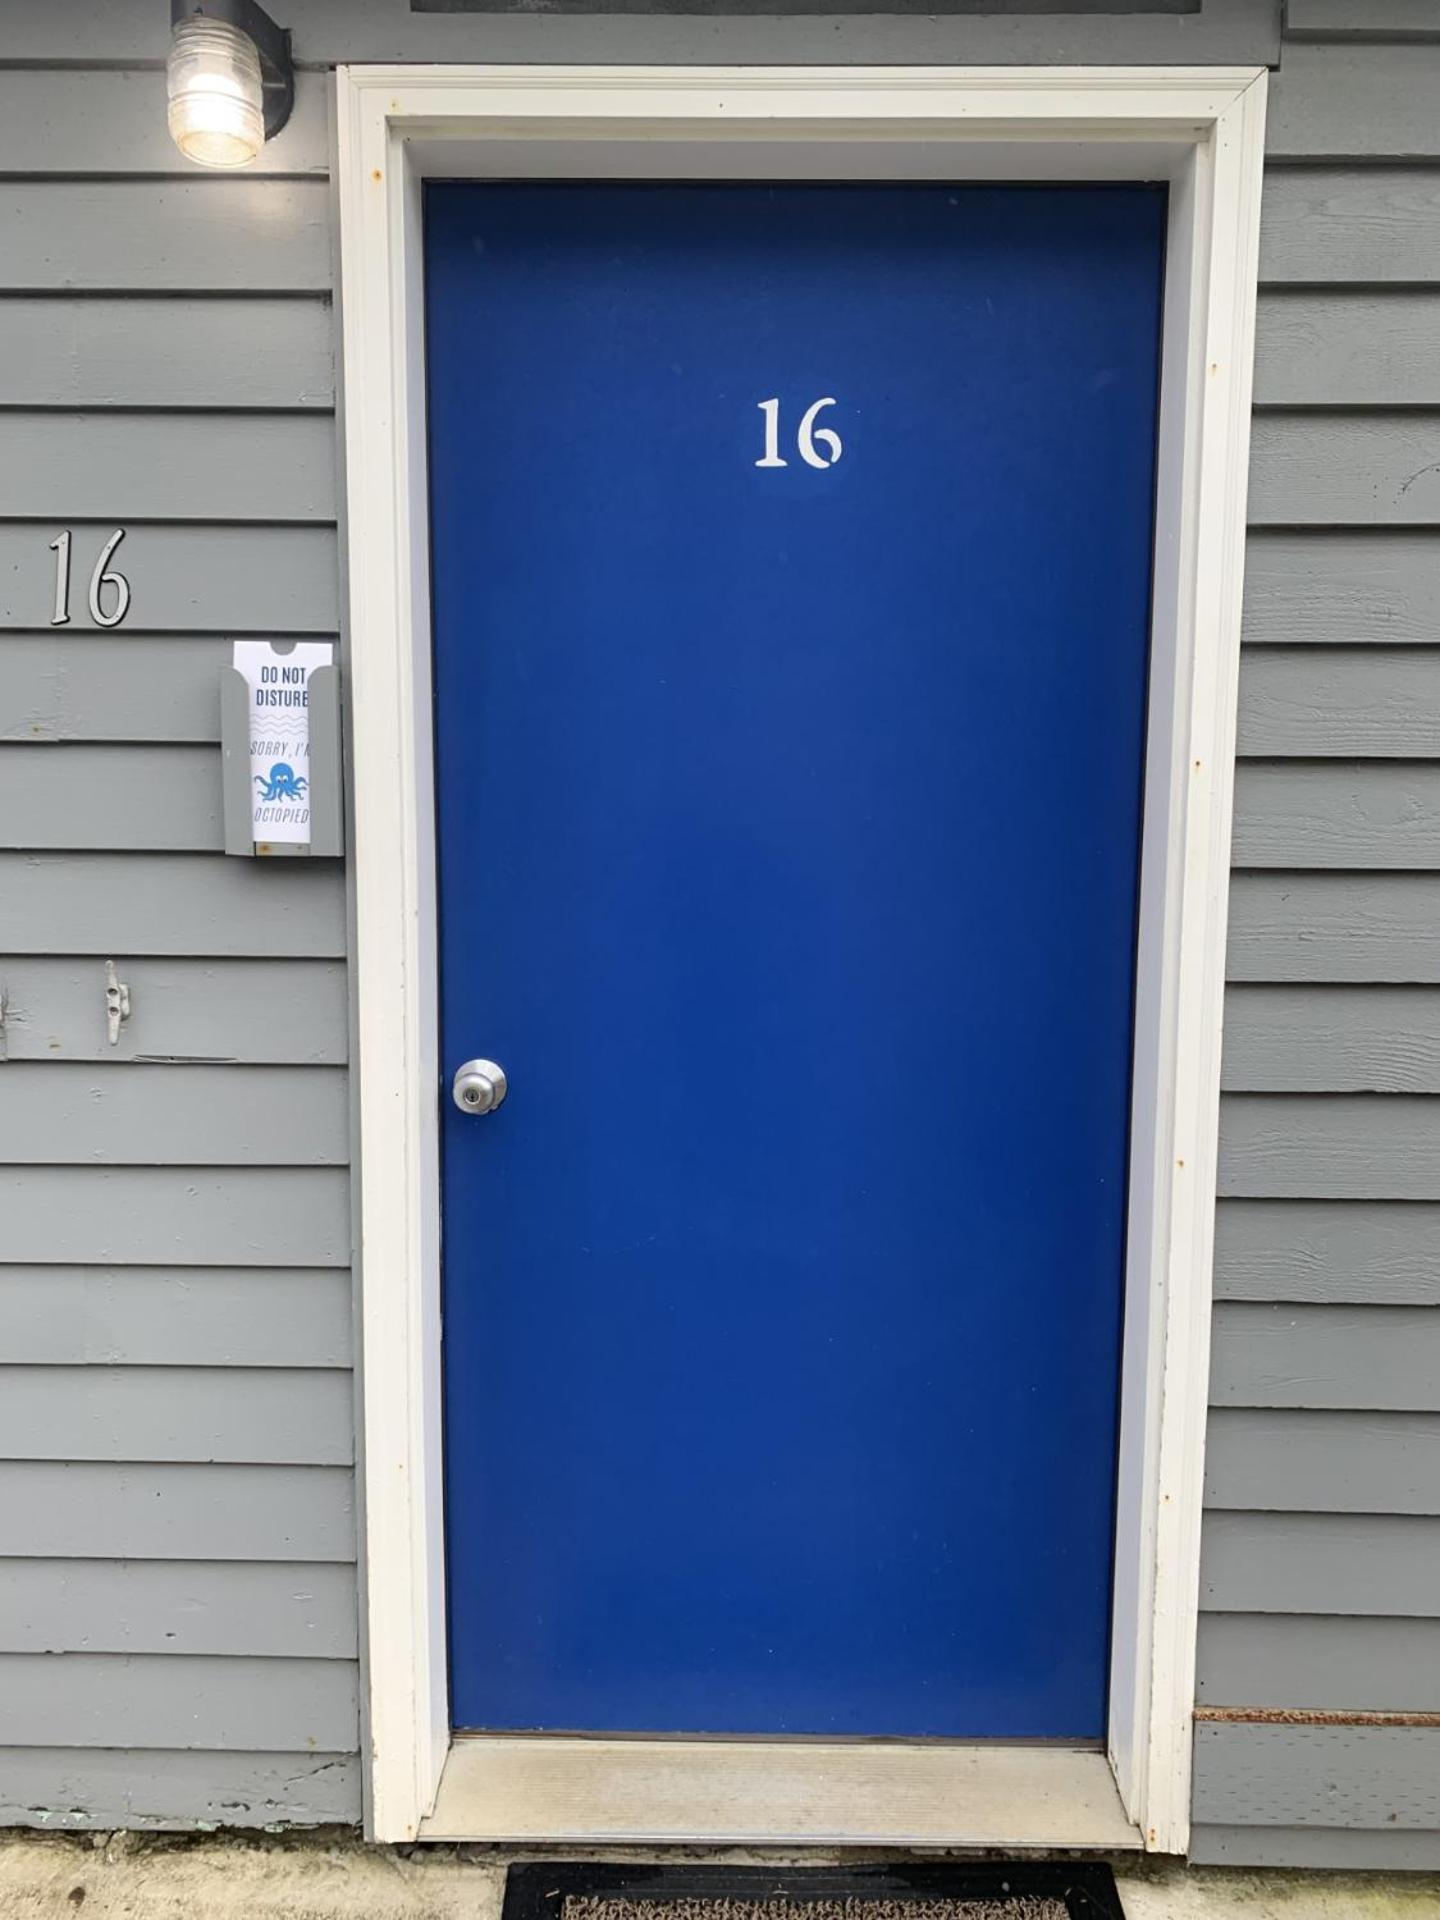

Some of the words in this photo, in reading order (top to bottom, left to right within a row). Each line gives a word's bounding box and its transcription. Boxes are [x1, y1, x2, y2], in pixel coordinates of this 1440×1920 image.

[755, 397, 842, 469] 16
[50, 529, 131, 627] 16
[261, 666, 278, 683] DO
[282, 667, 306, 684] NOT
[254, 807, 310, 824] OCTOPIED
